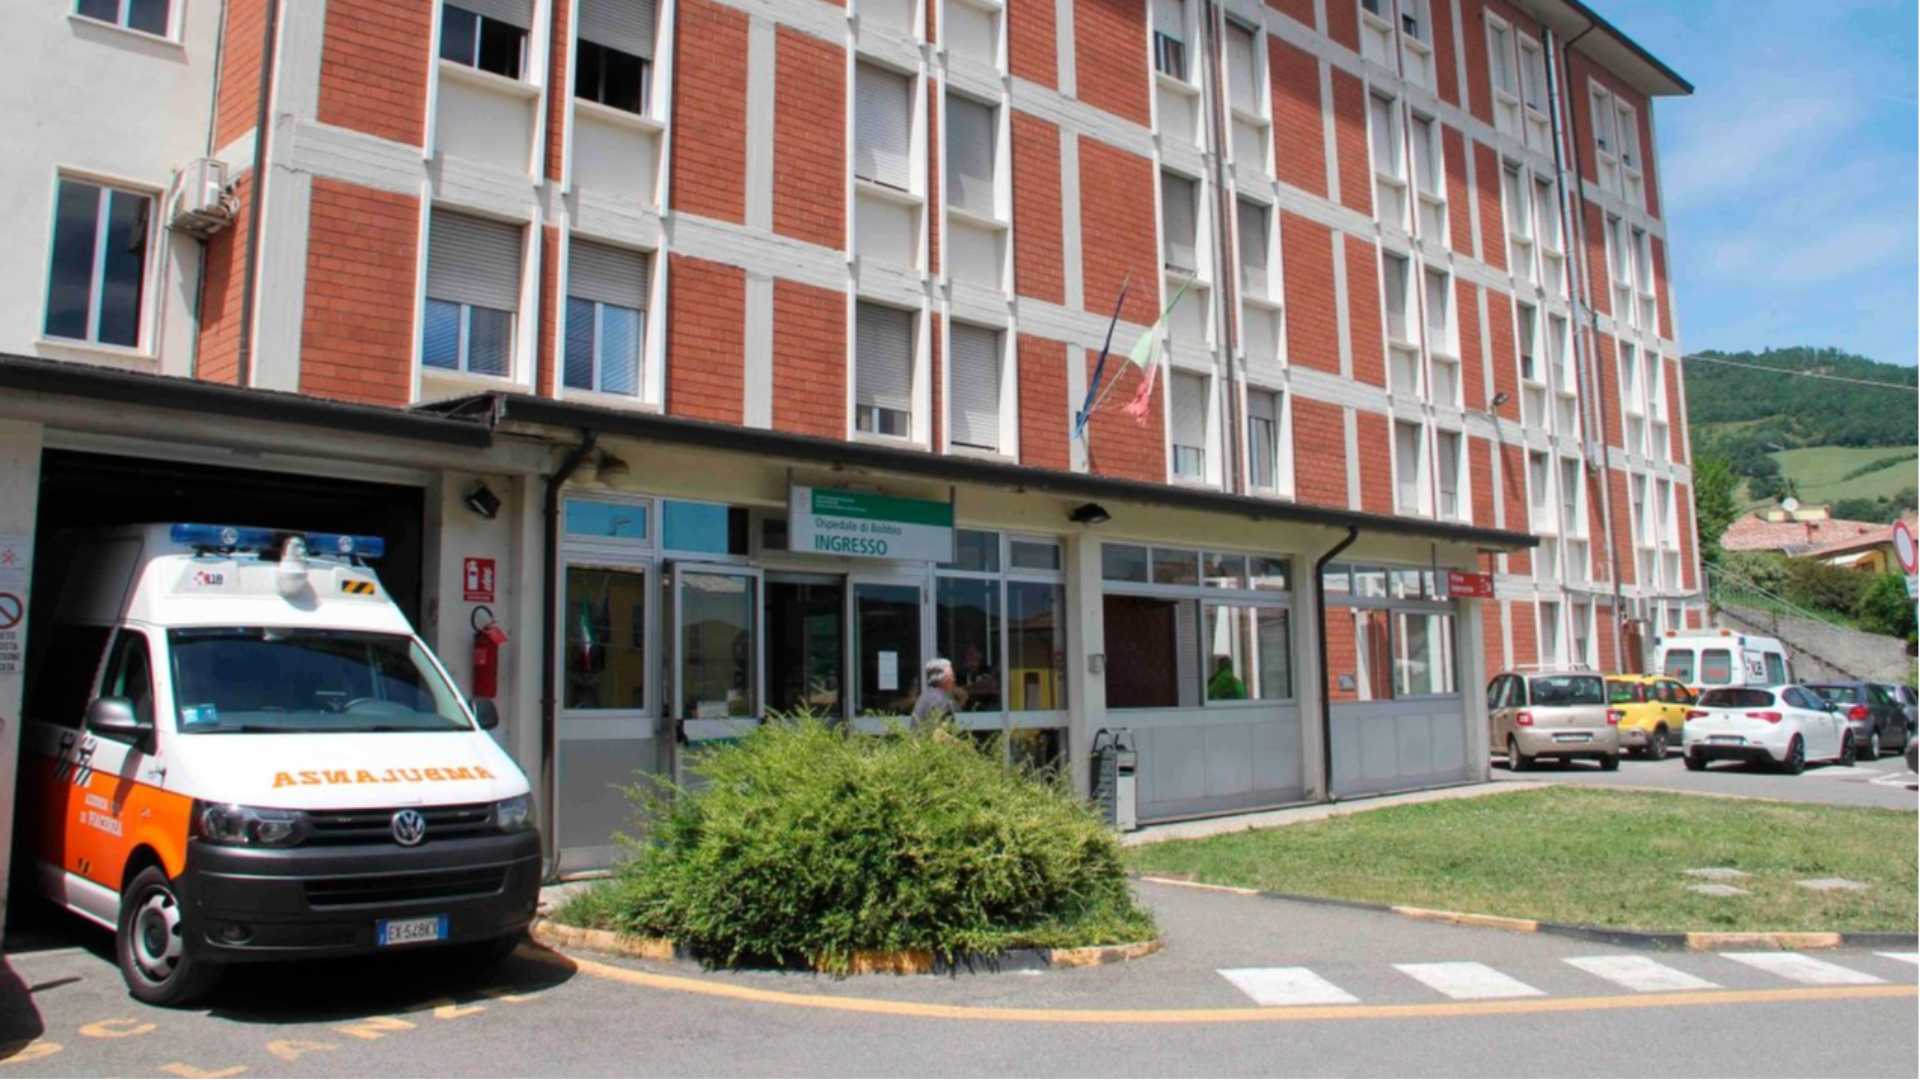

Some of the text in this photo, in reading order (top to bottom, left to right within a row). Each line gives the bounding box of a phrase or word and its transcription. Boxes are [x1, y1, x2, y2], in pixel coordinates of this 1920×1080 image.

[815, 517, 858, 532] Ospedale
[859, 521, 870, 533] di
[815, 533, 888, 556] INGRESSO
